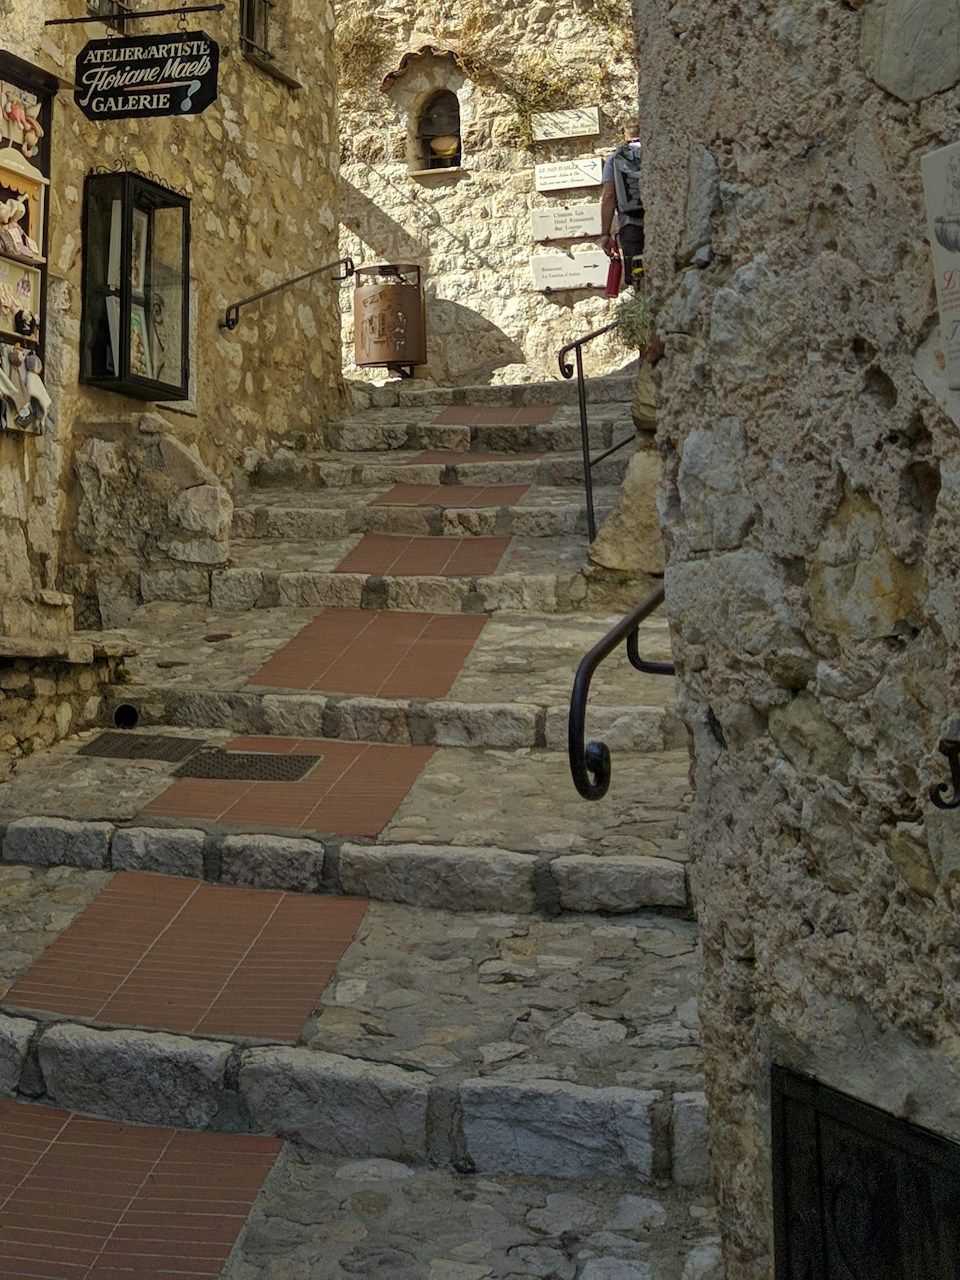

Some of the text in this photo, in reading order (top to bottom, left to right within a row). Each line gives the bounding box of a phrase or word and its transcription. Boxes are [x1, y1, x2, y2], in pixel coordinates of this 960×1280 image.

[83, 47, 142, 64] ATELIER
[79, 64, 160, 107] Floriane
[91, 93, 171, 113] GALERIE
